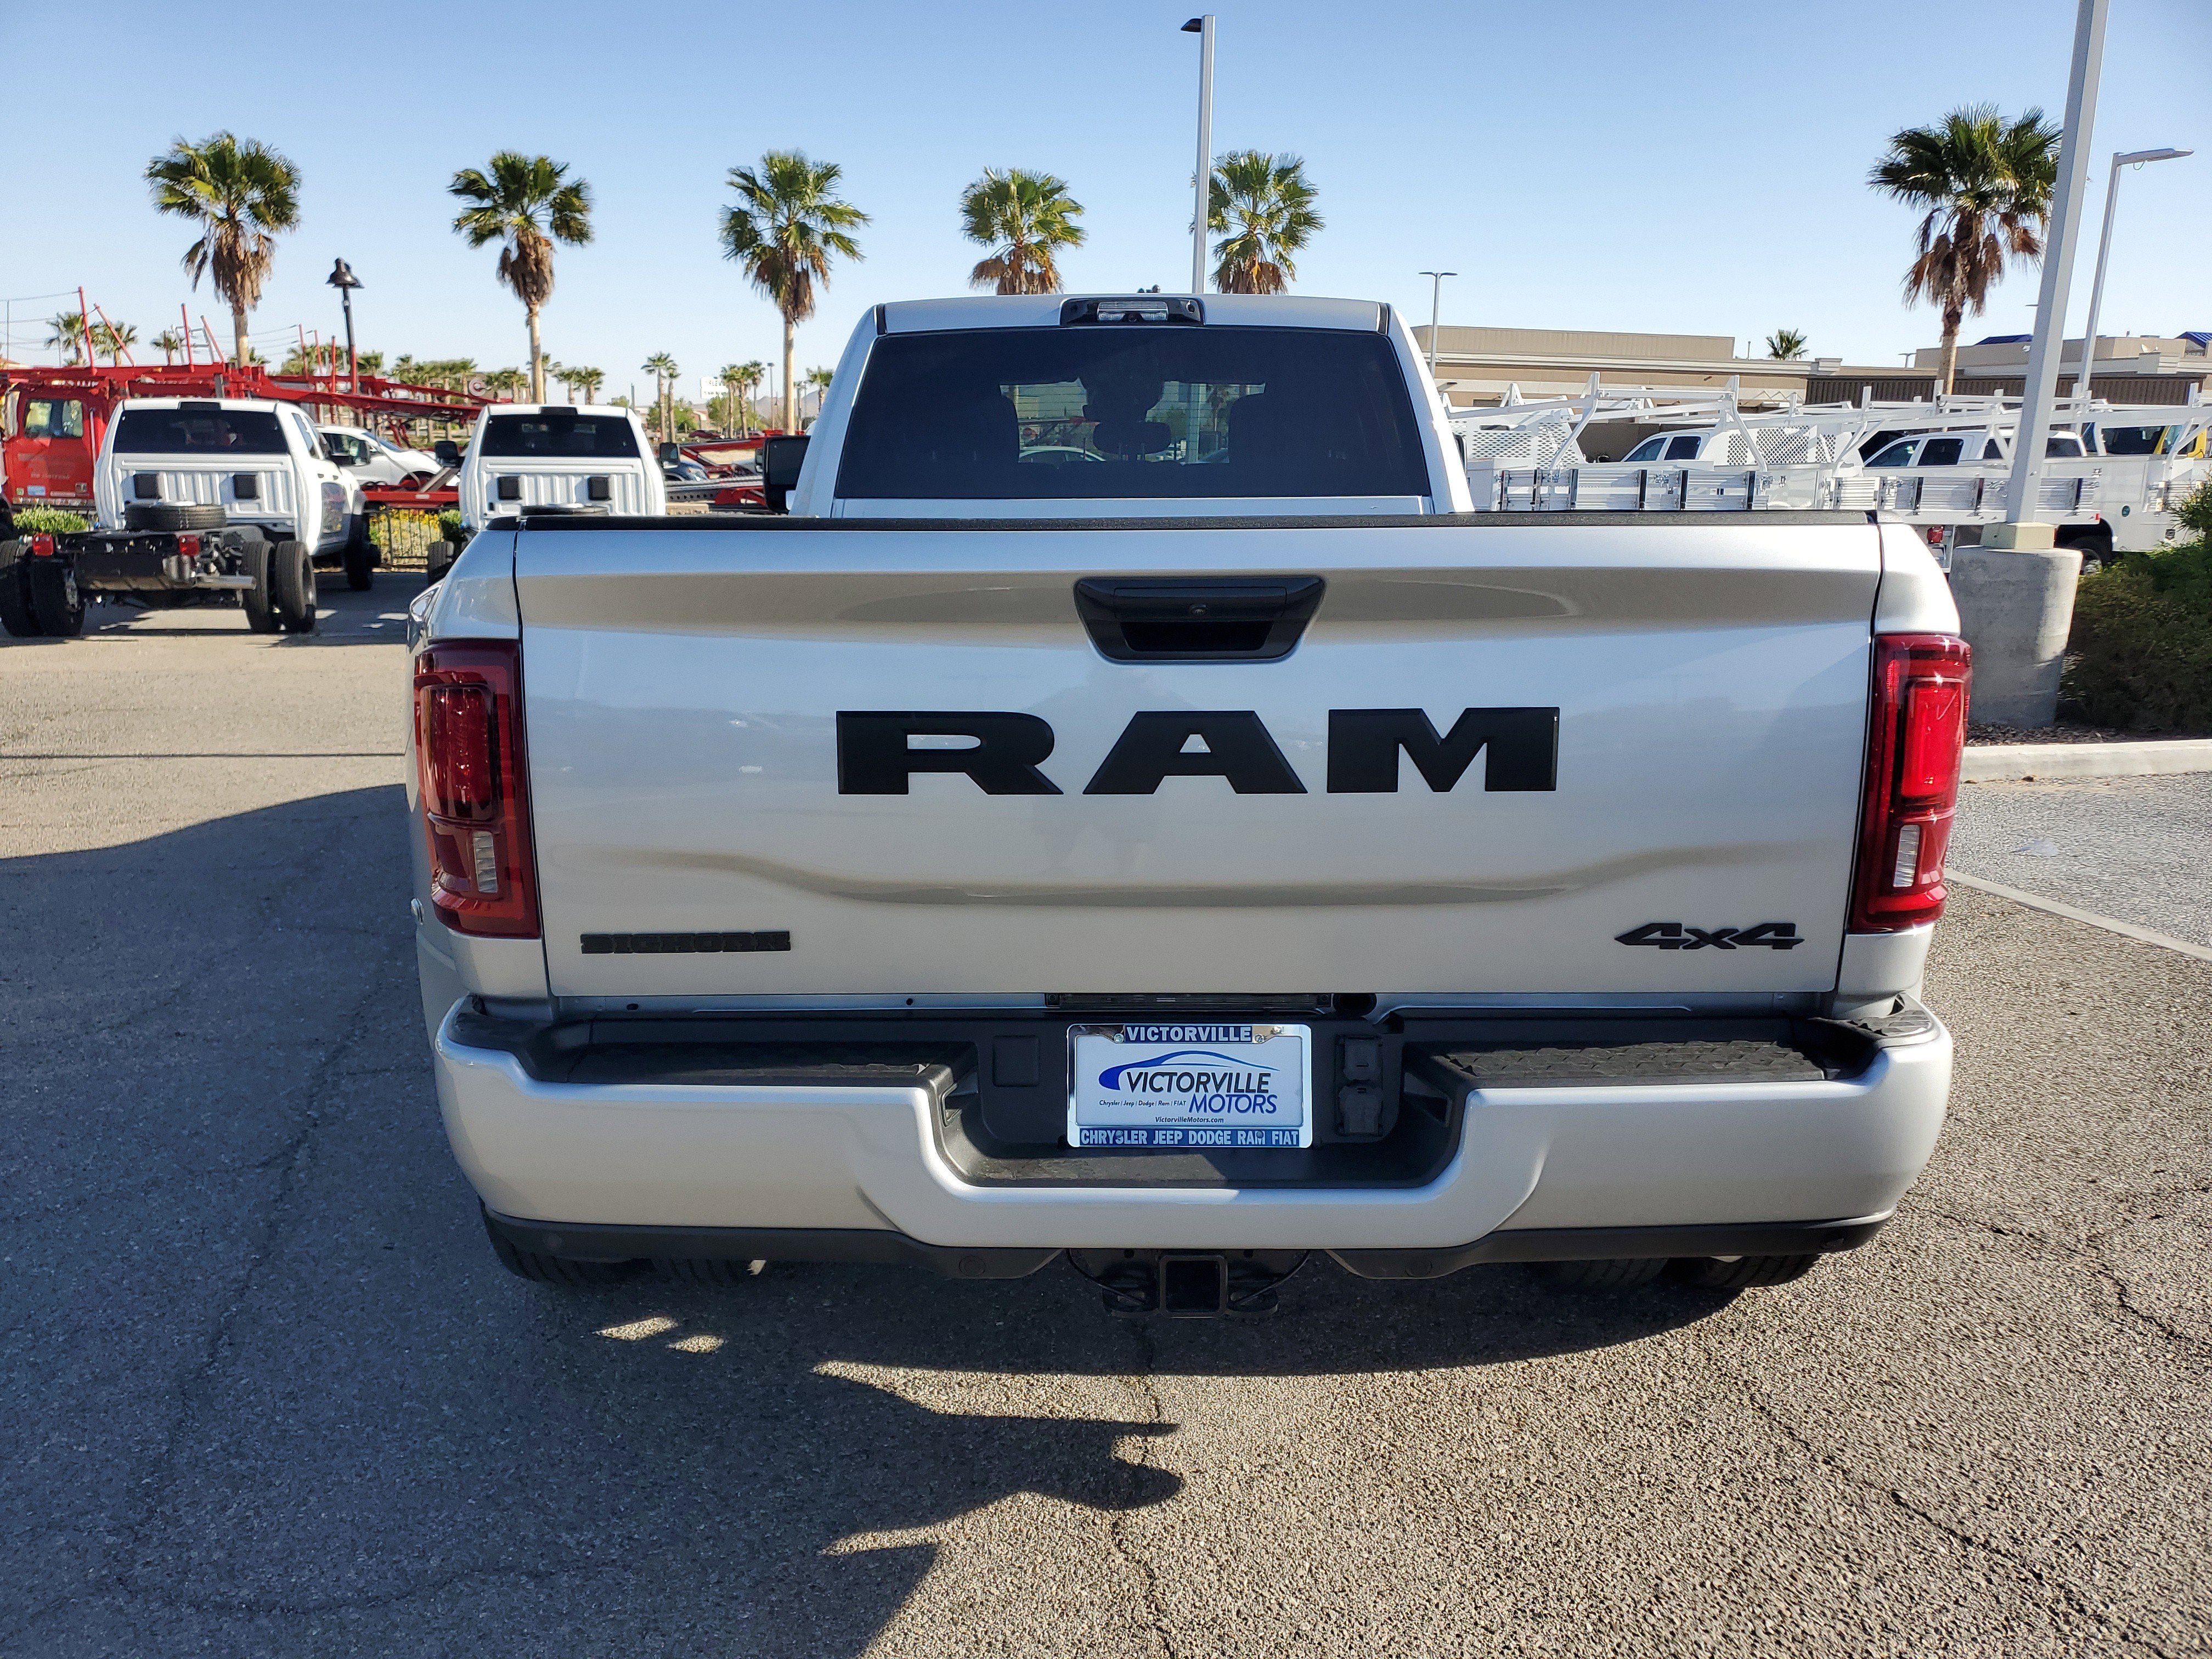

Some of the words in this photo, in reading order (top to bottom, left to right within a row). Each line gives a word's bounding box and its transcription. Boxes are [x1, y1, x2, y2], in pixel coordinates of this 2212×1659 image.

[836, 707, 1560, 795] RAM
[1614, 923, 1805, 950] 4x4
[1126, 1026, 1251, 1041] VICTORVILLE
[1126, 1071, 1272, 1094] VICTORVILLE
[1099, 1099, 1120, 1108] Chrysler
[1188, 1093, 1278, 1114] MOTORS
[1153, 1130, 1183, 1145] JEEP
[1188, 1130, 1232, 1145] DODGE
[1237, 1130, 1266, 1145] RAM
[1272, 1130, 1299, 1146] FIAT
